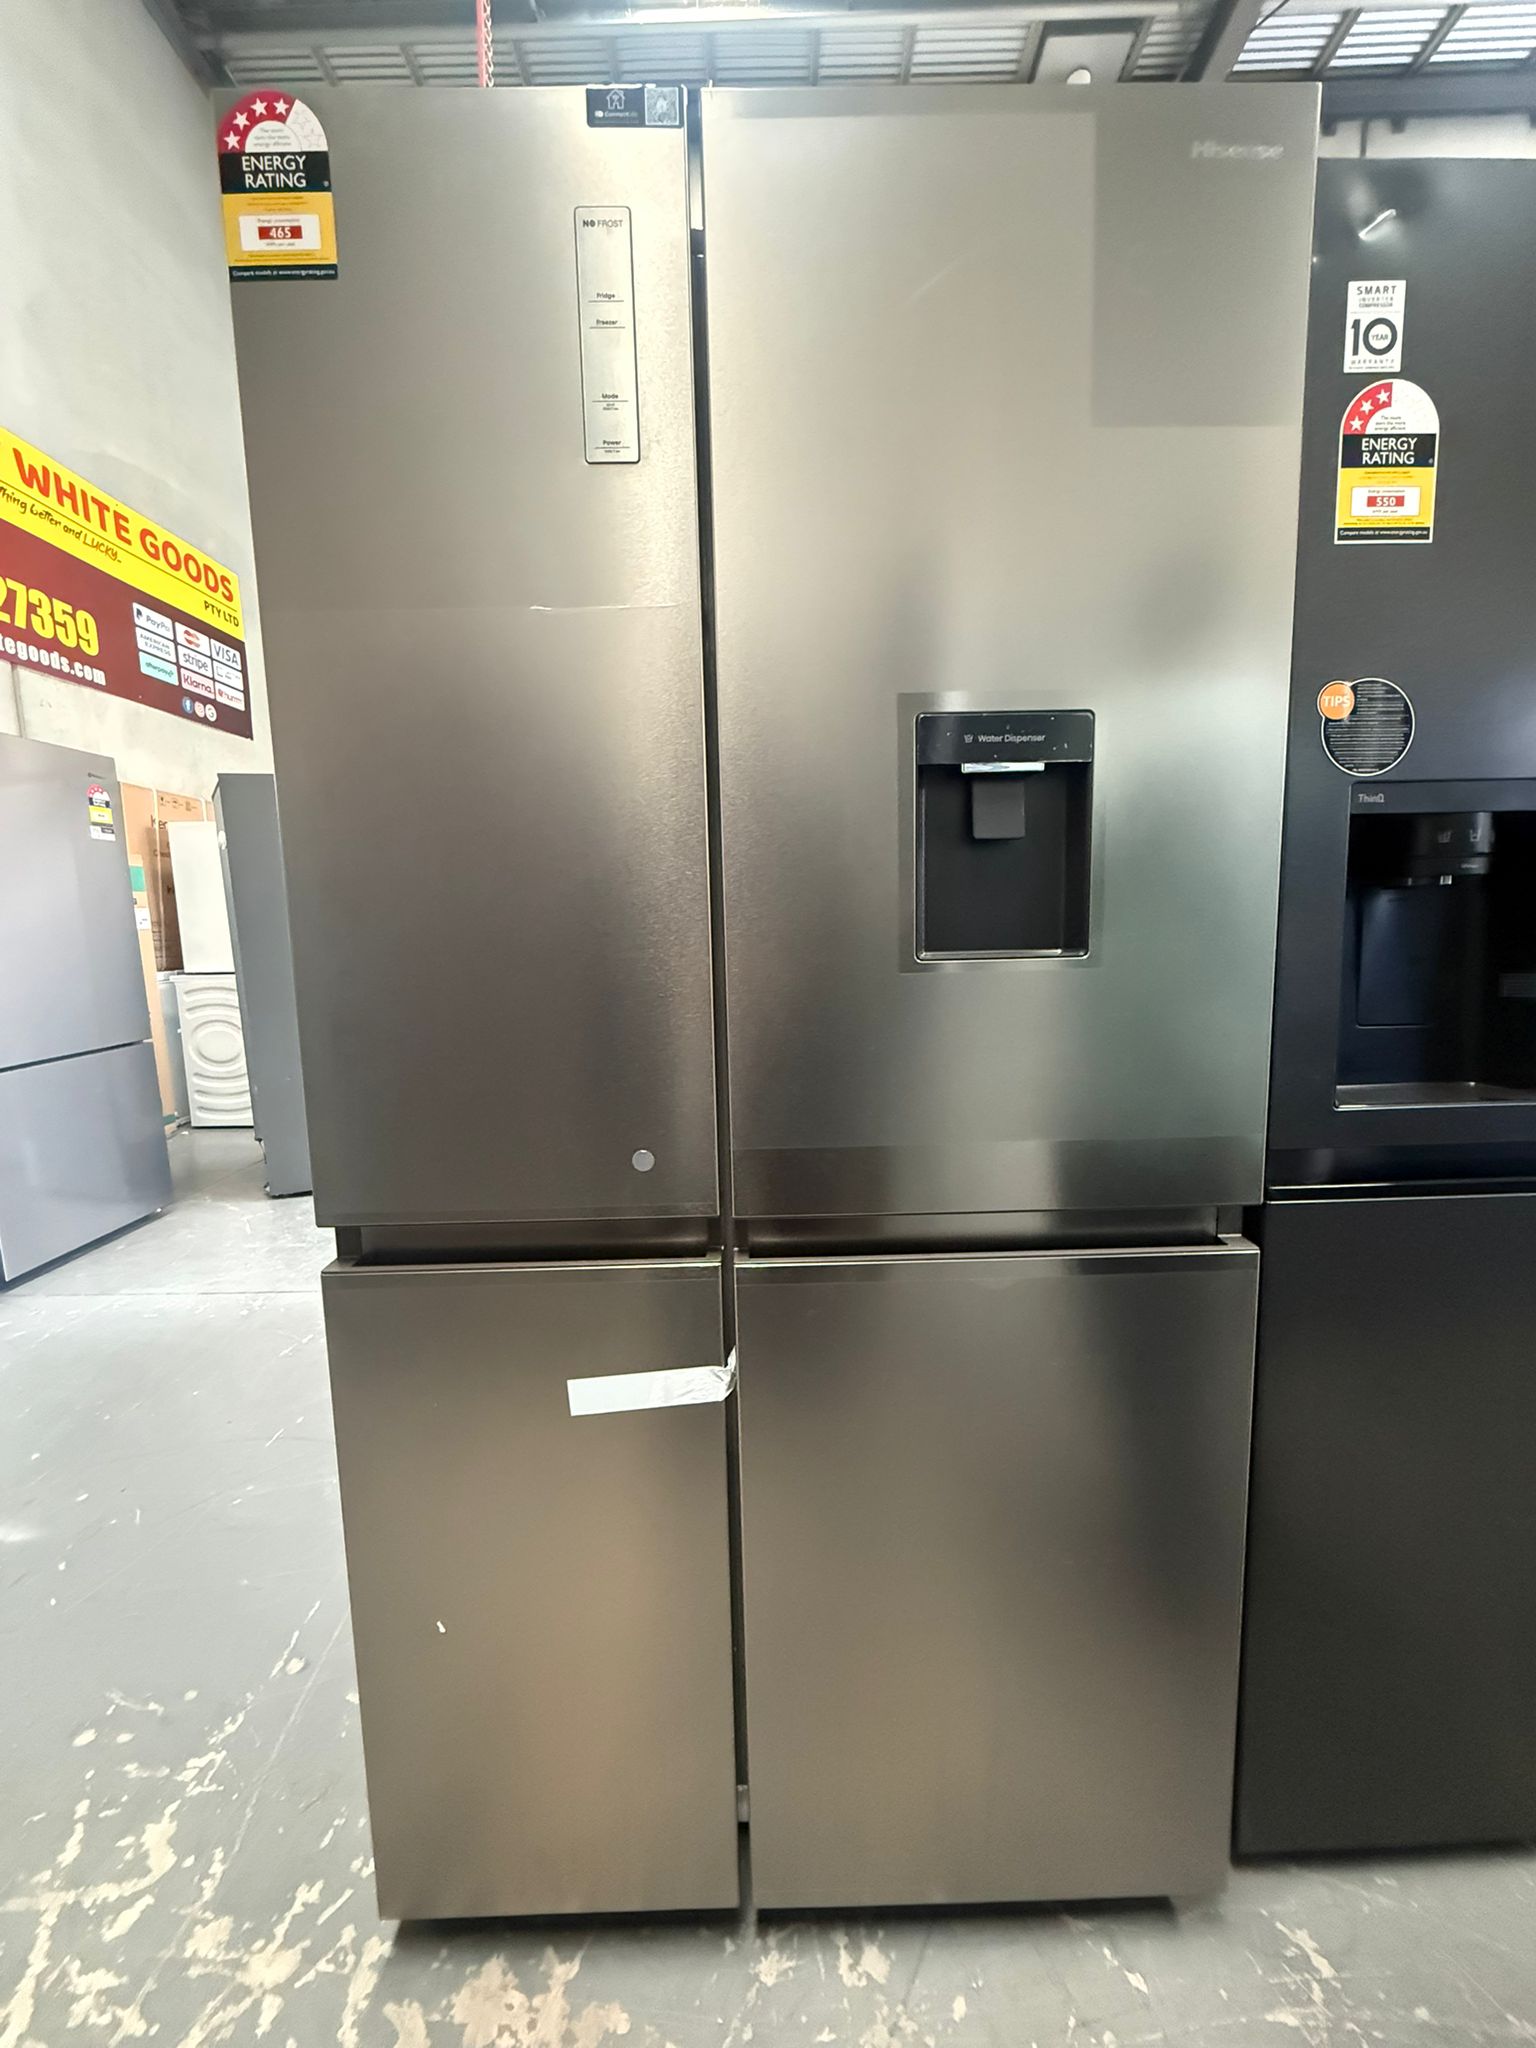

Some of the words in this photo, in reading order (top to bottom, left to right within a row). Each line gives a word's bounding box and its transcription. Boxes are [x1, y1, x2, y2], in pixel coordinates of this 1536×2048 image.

[241, 155, 306, 171] ENERGY
[245, 172, 307, 189] RATING
[597, 219, 623, 228] FROST
[269, 226, 291, 239] 465
[1356, 285, 1397, 296] SMART
[596, 318, 618, 326] Freezer
[1350, 317, 1398, 356] 10
[1372, 333, 1389, 341] YEAR
[1361, 437, 1418, 451] ENERGY
[1362, 452, 1415, 465] RATING
[1375, 496, 1397, 507] 550
[12, 447, 133, 546] WHITE
[139, 527, 234, 603] GOODS
[30, 503, 62, 528] better
[62, 524, 84, 541] and
[203, 600, 221, 618] PTY
[222, 611, 240, 627] LTD
[146, 614, 171, 633] PayPa
[213, 642, 239, 667] VISA
[182, 652, 209, 672] stripe
[1323, 695, 1351, 708] TIPS
[977, 734, 1003, 743] Water
[1004, 734, 1046, 744] Dispenser
[1358, 793, 1385, 803] ThinQ
